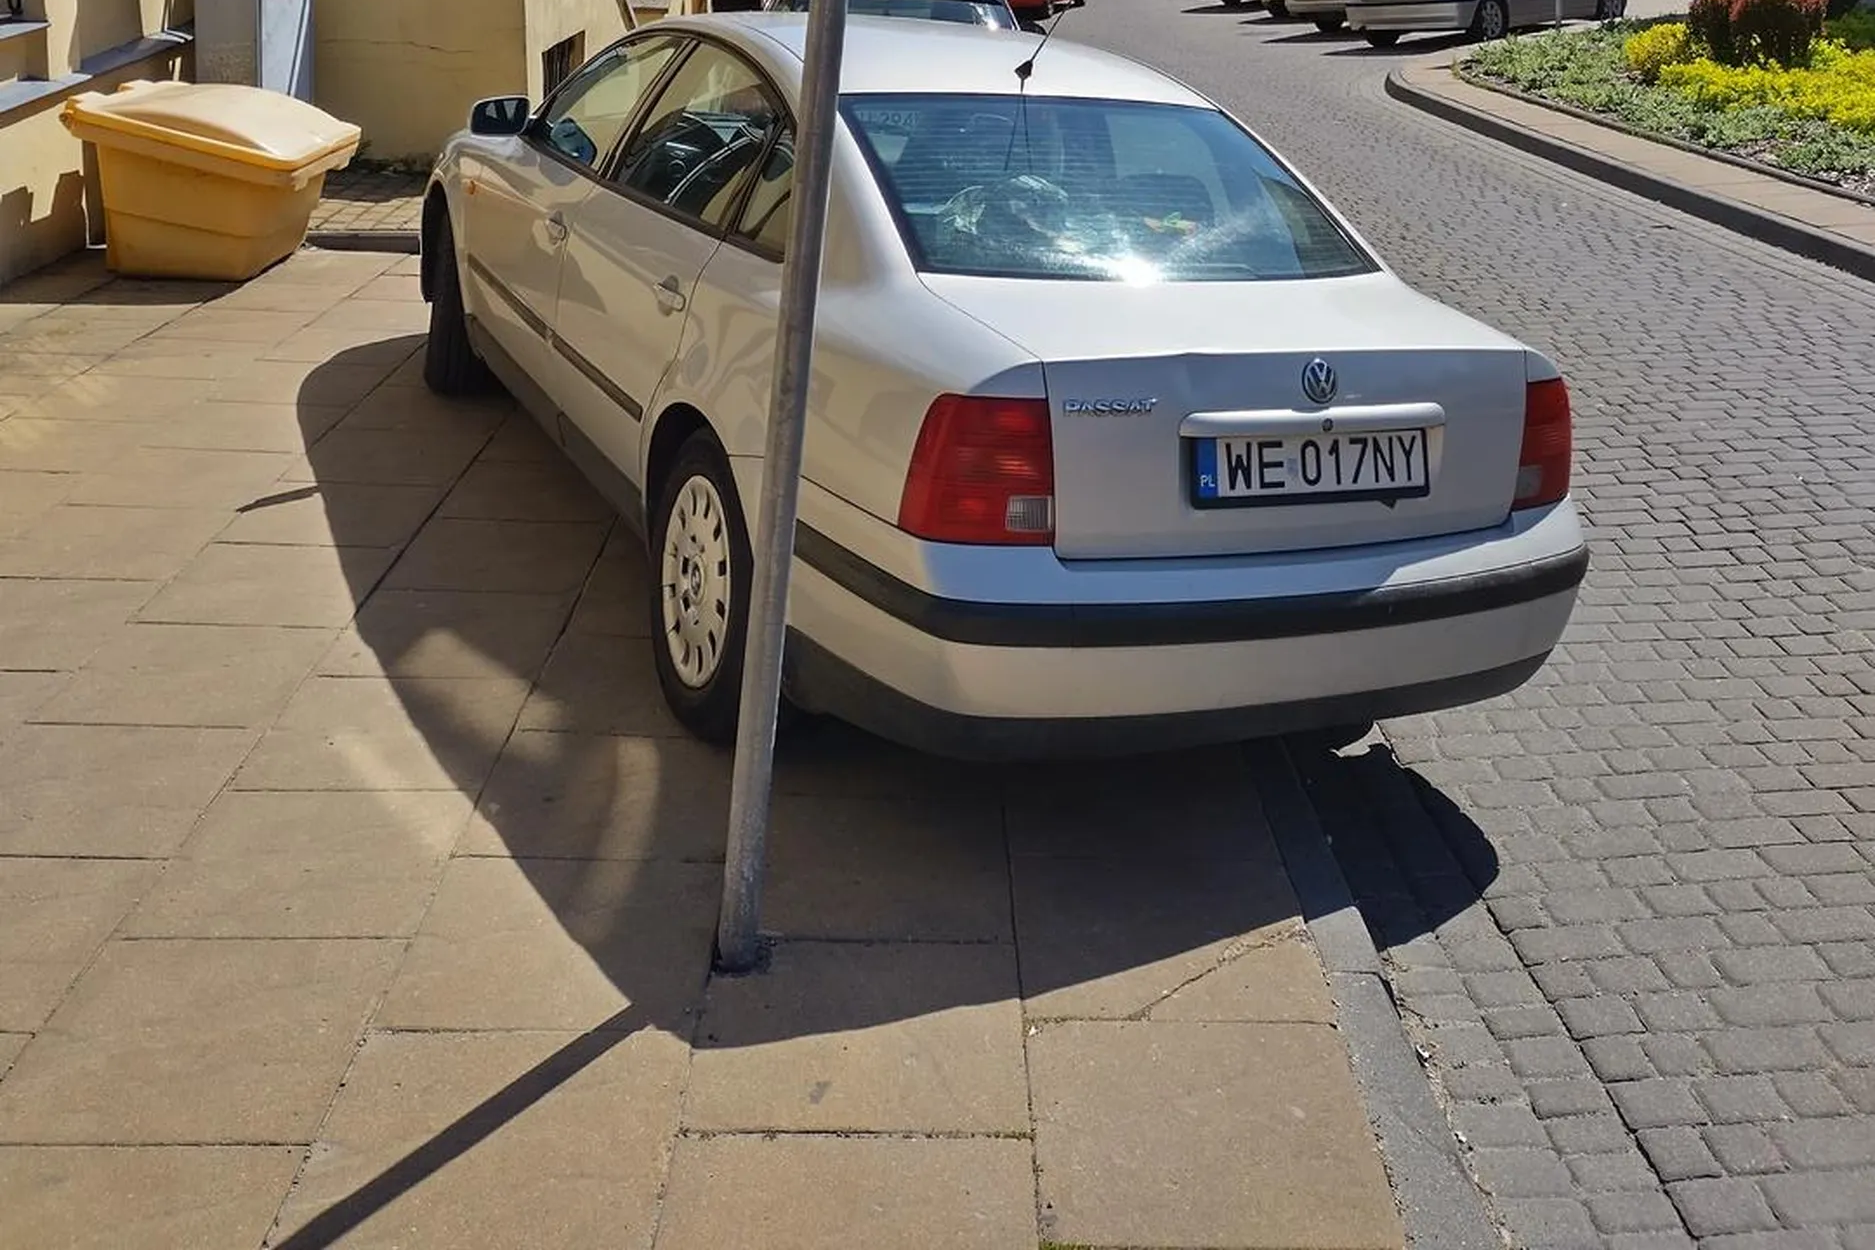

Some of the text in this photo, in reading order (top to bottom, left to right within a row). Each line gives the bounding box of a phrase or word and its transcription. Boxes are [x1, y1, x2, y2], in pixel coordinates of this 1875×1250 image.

[1063, 398, 1158, 417] PASSAT
[1224, 434, 1417, 490] WE 017NY
[1199, 474, 1216, 488] PL
